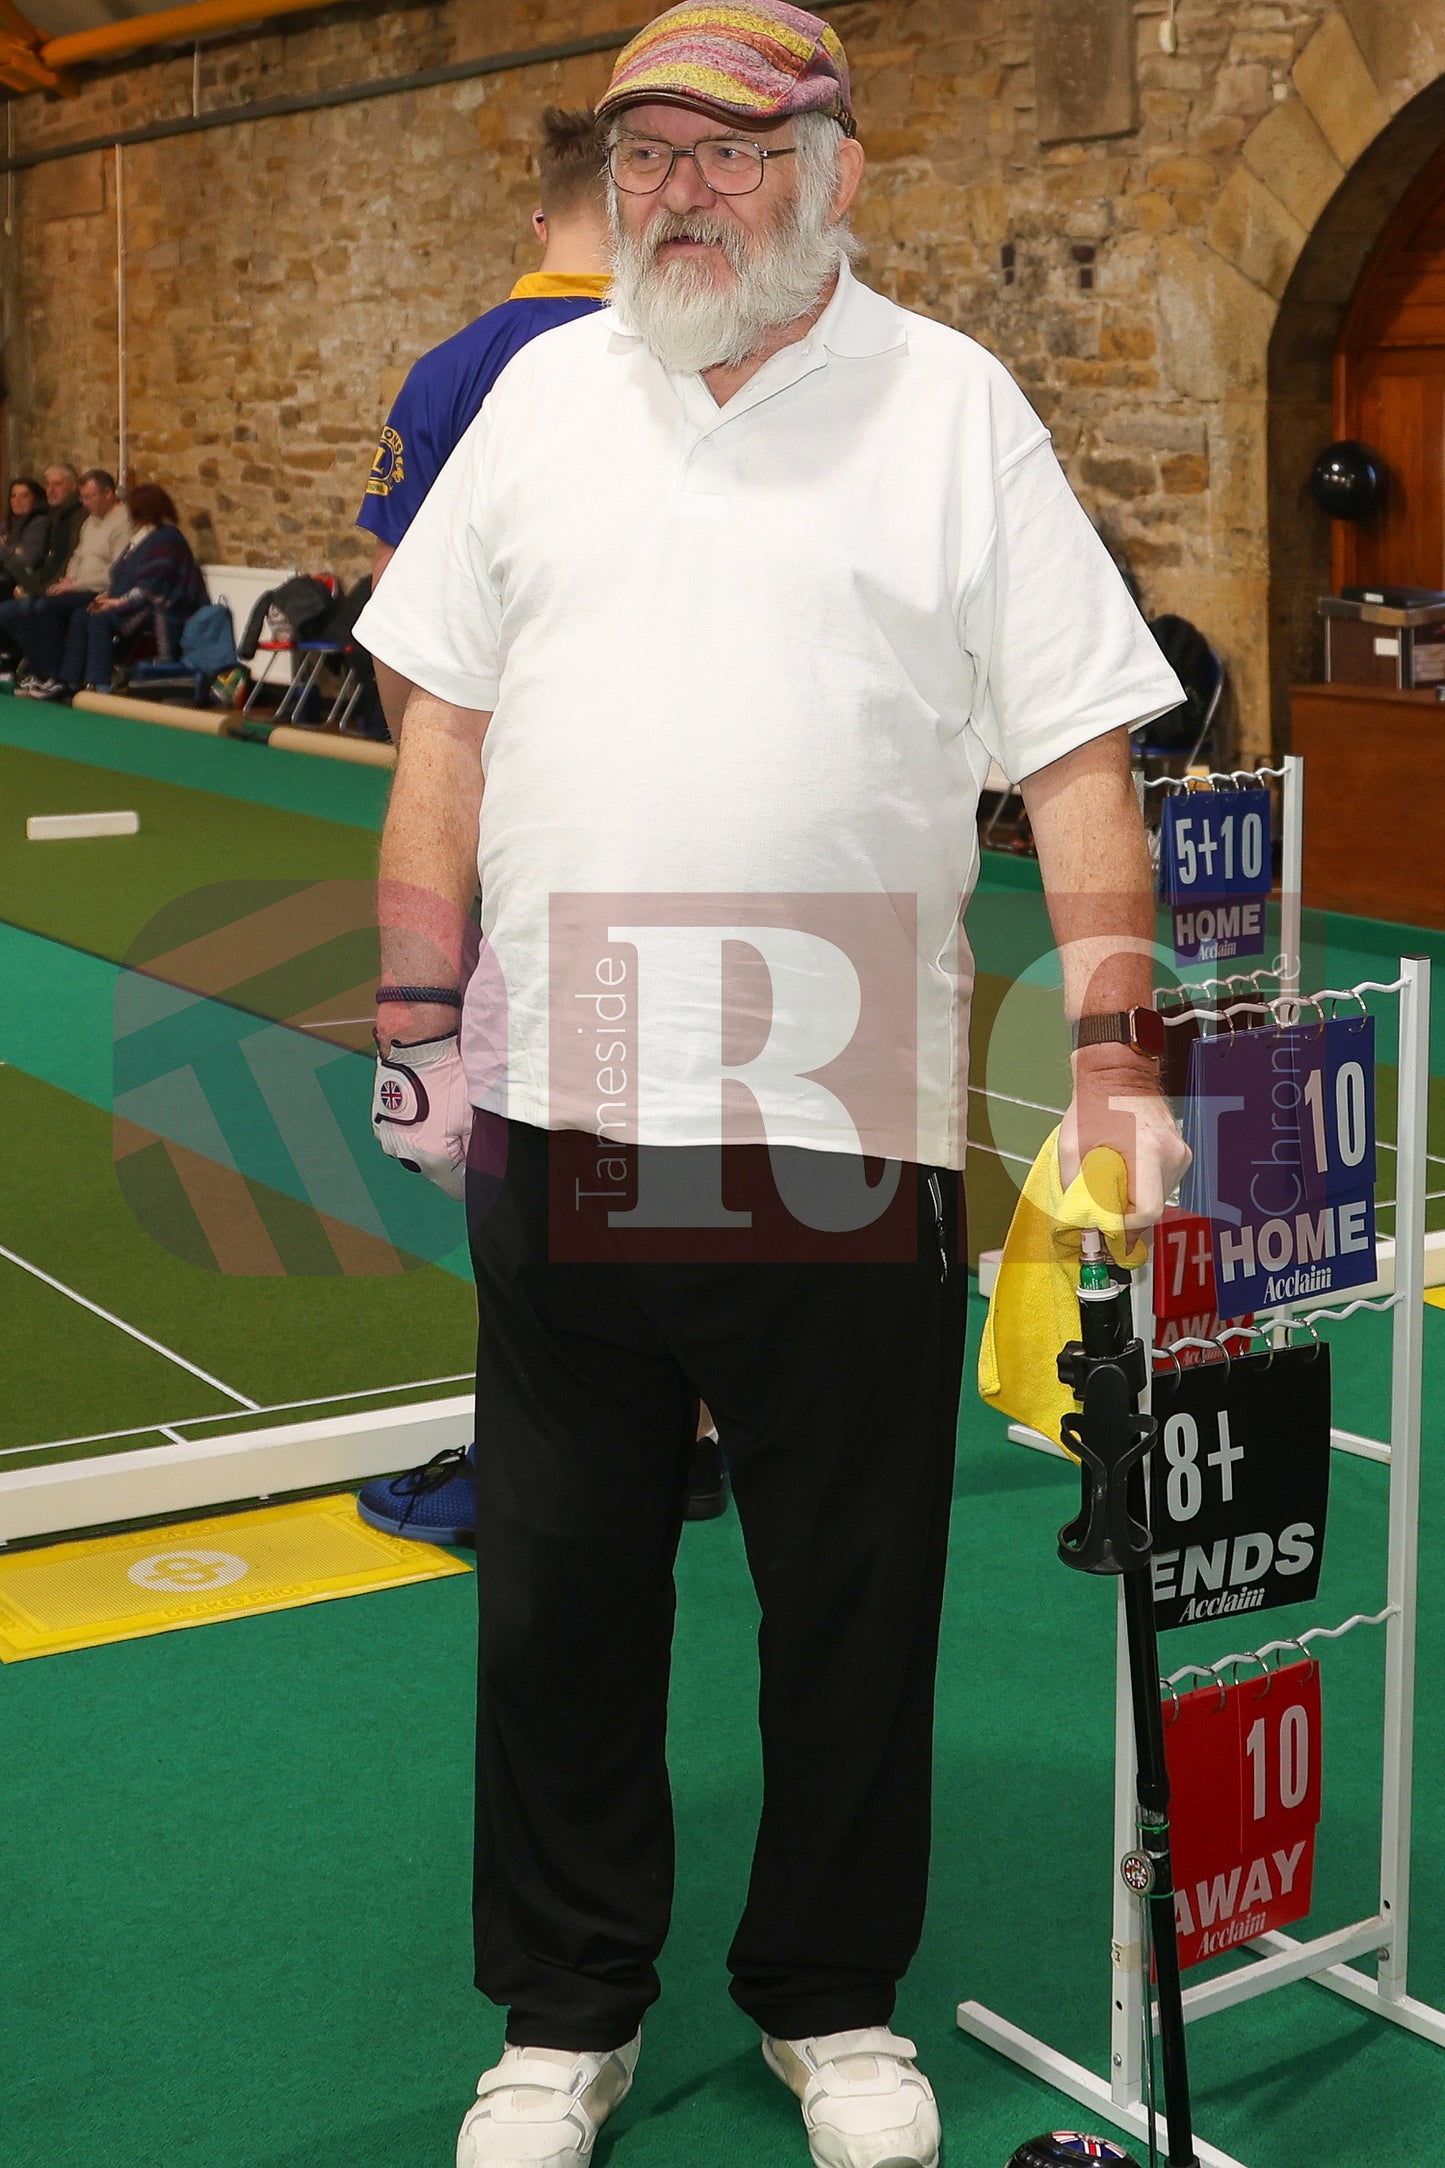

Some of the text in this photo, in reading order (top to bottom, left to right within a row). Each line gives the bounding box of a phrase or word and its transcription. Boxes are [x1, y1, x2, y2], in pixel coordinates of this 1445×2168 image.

[1175, 903, 1262, 947] HOME
[1197, 941, 1237, 962] Acclaim
[1303, 1061, 1367, 1174] 10
[1219, 1200, 1369, 1284] HOME
[1263, 1264, 1332, 1304] Acclaim
[1163, 1410, 1245, 1522] 8+
[1152, 1522, 1316, 1602] ENDS
[1179, 1586, 1266, 1624] Acclaim
[1246, 1704, 1309, 1821] 10
[1174, 1840, 1307, 1937] AWAY
[1196, 1911, 1267, 1959] Acclaim
